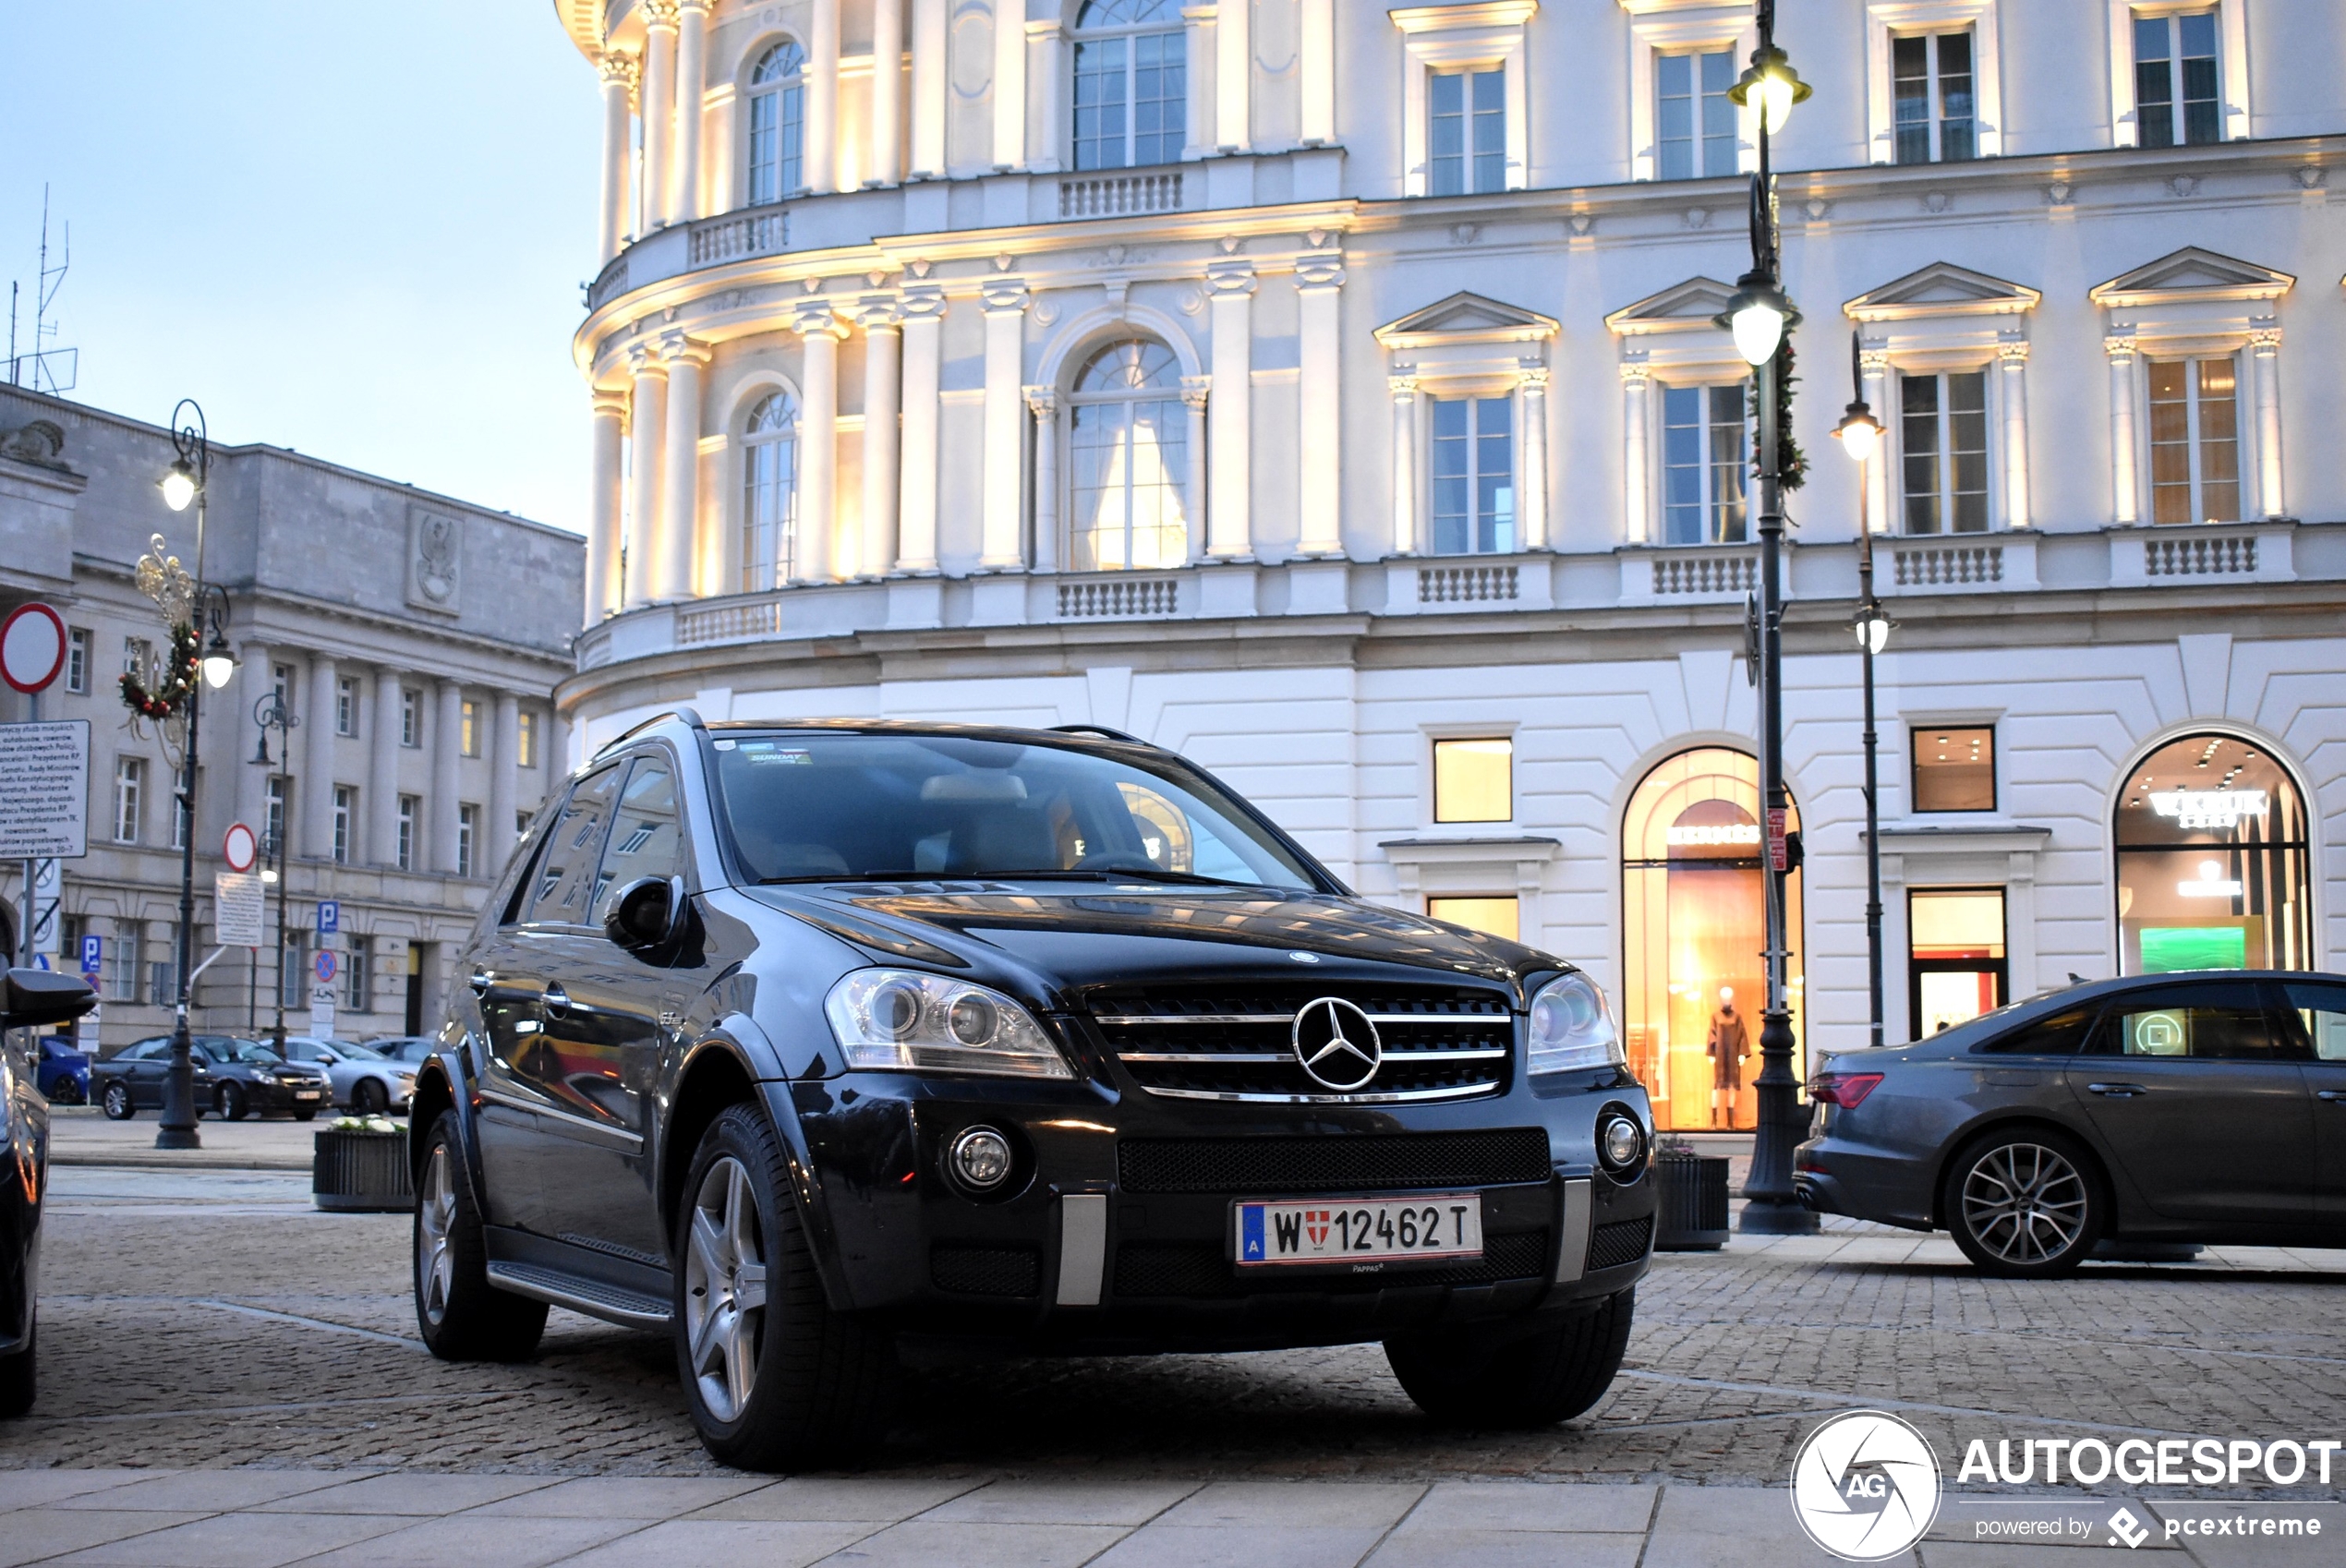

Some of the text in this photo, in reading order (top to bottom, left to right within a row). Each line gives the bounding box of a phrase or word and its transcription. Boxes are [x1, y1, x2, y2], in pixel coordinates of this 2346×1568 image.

[1274, 1205, 1468, 1253] W 12462 T
[1248, 1240, 1259, 1253] A
